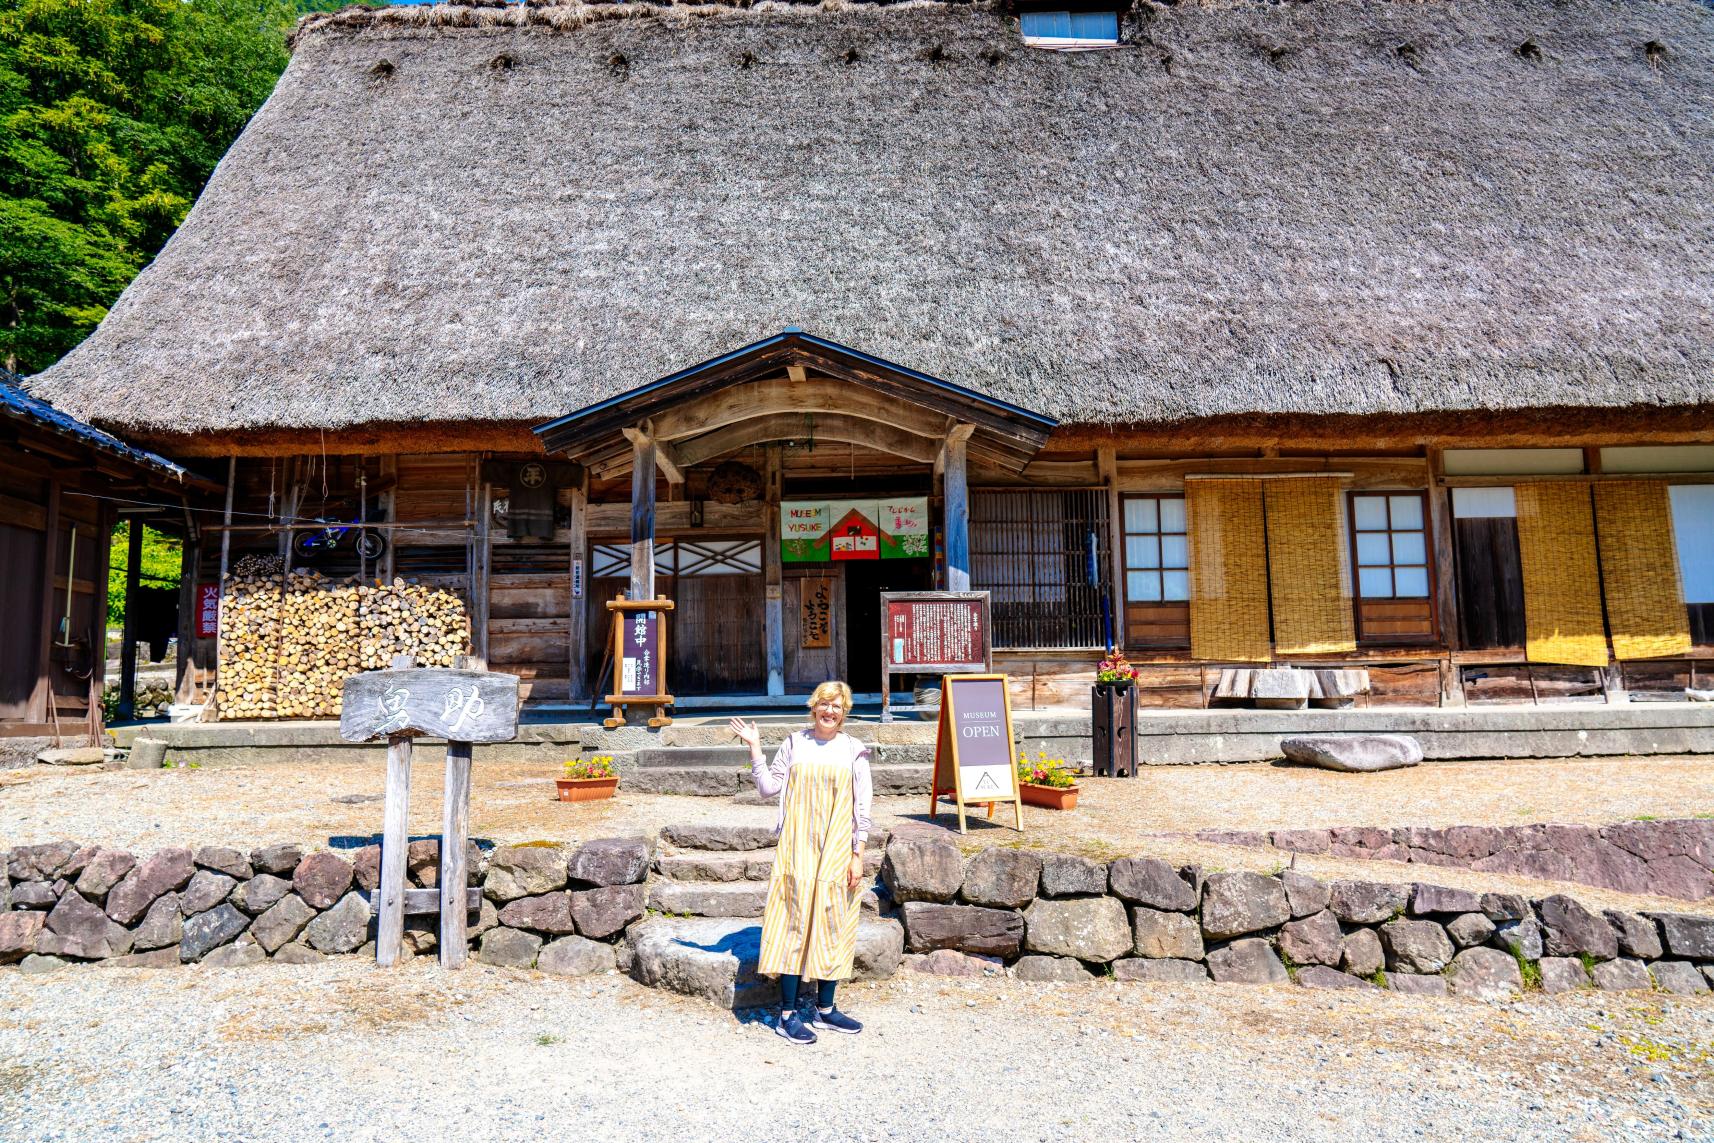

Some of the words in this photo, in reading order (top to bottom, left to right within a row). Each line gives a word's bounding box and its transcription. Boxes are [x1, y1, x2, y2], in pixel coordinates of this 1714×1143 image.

[788, 522, 822, 533] YUSUKE
[202, 587, 218, 634] 火気厳禁
[634, 612, 648, 648] 開館中
[962, 711, 997, 719] MUSEUM
[962, 725, 1000, 738] OPEN
